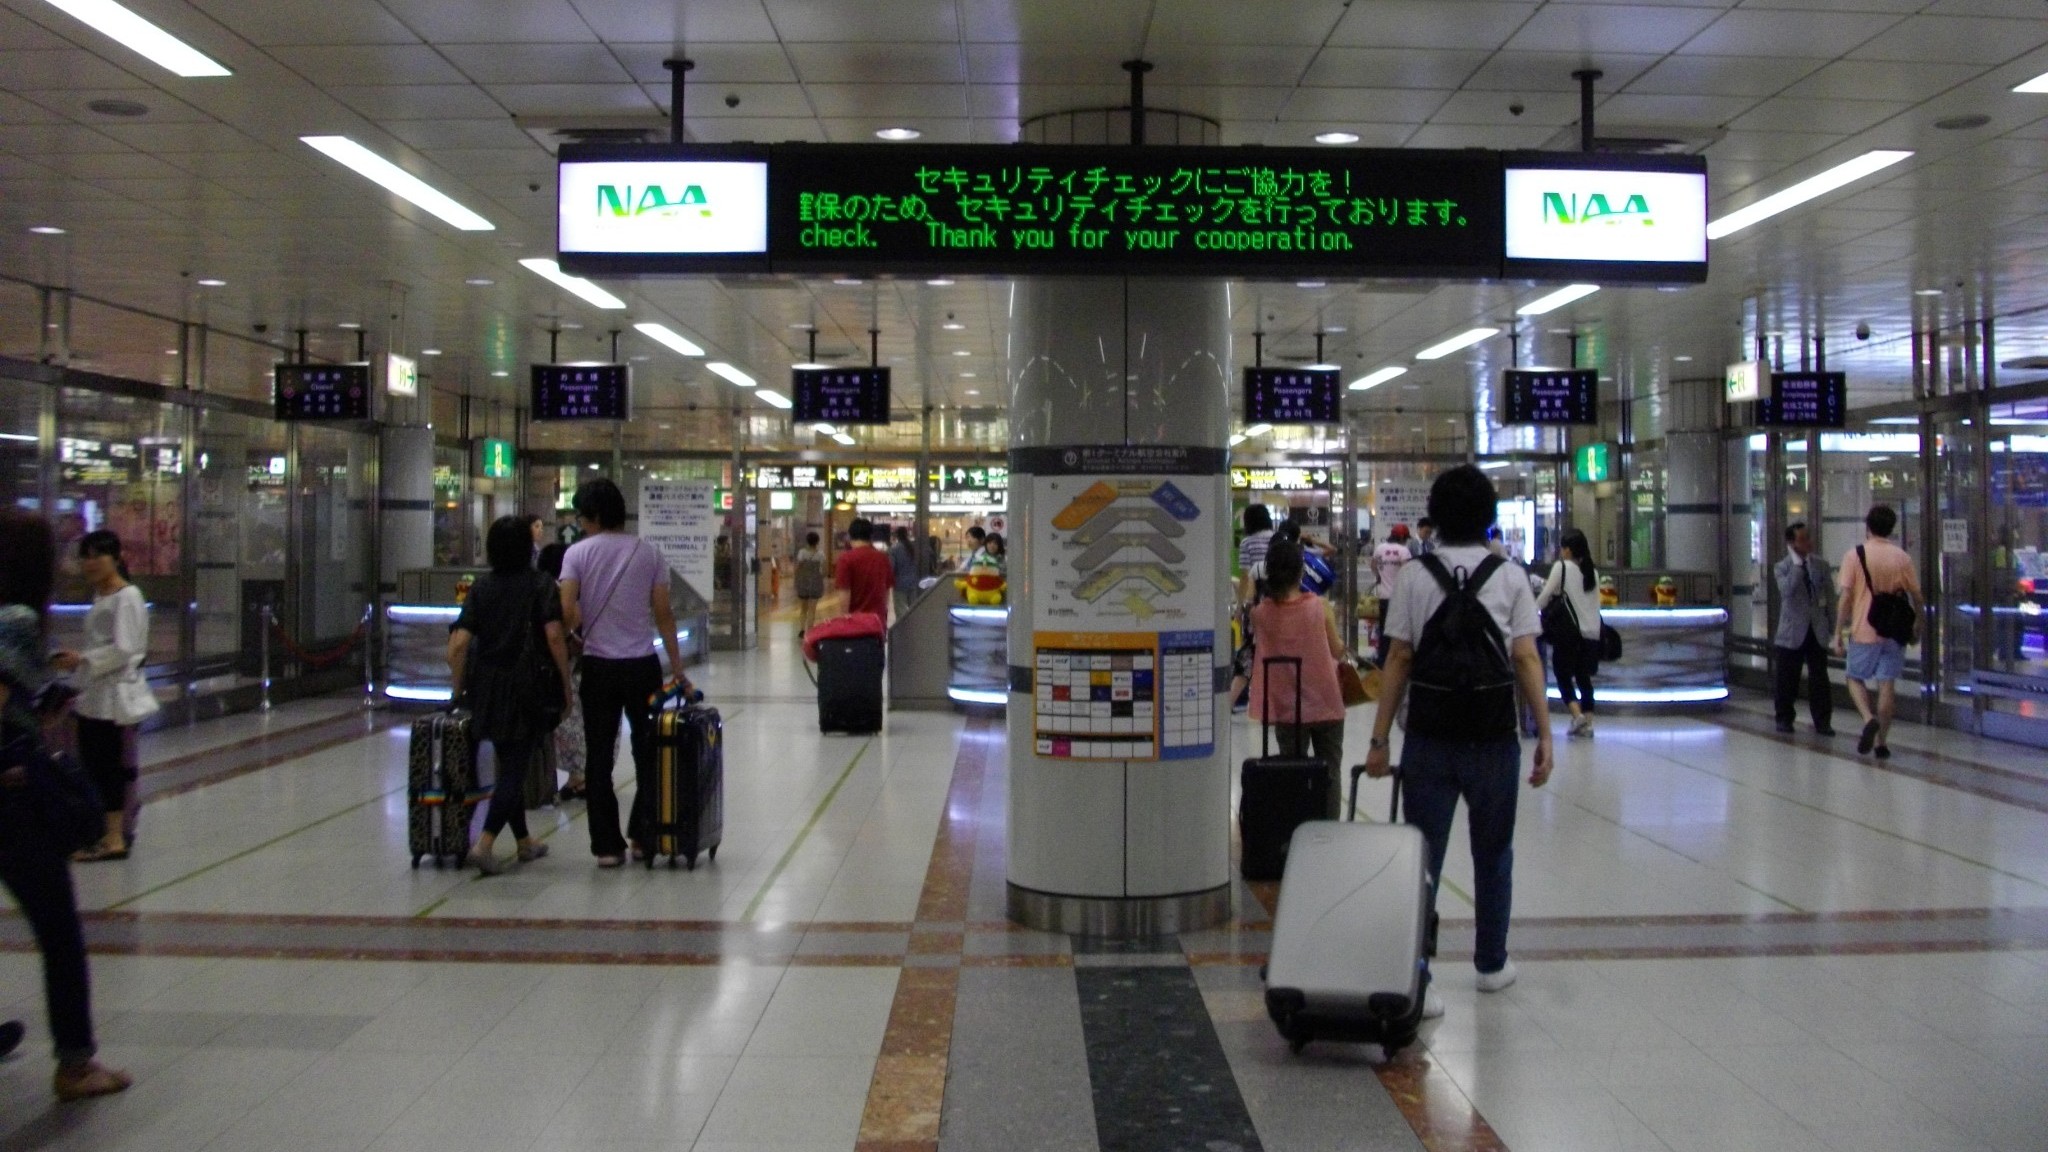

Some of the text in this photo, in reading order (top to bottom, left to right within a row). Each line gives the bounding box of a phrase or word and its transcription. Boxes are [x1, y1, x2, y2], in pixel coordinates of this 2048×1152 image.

[913, 165, 1350, 197] セキュリティチェックにご協力を！
[597, 185, 713, 218] NAA
[1543, 192, 1655, 226] NAA
[800, 221, 1354, 251] check. Thank you for your cooperation.
[1273, 387, 1313, 396] Passengers
[663, 543, 698, 551] TERMINAL
